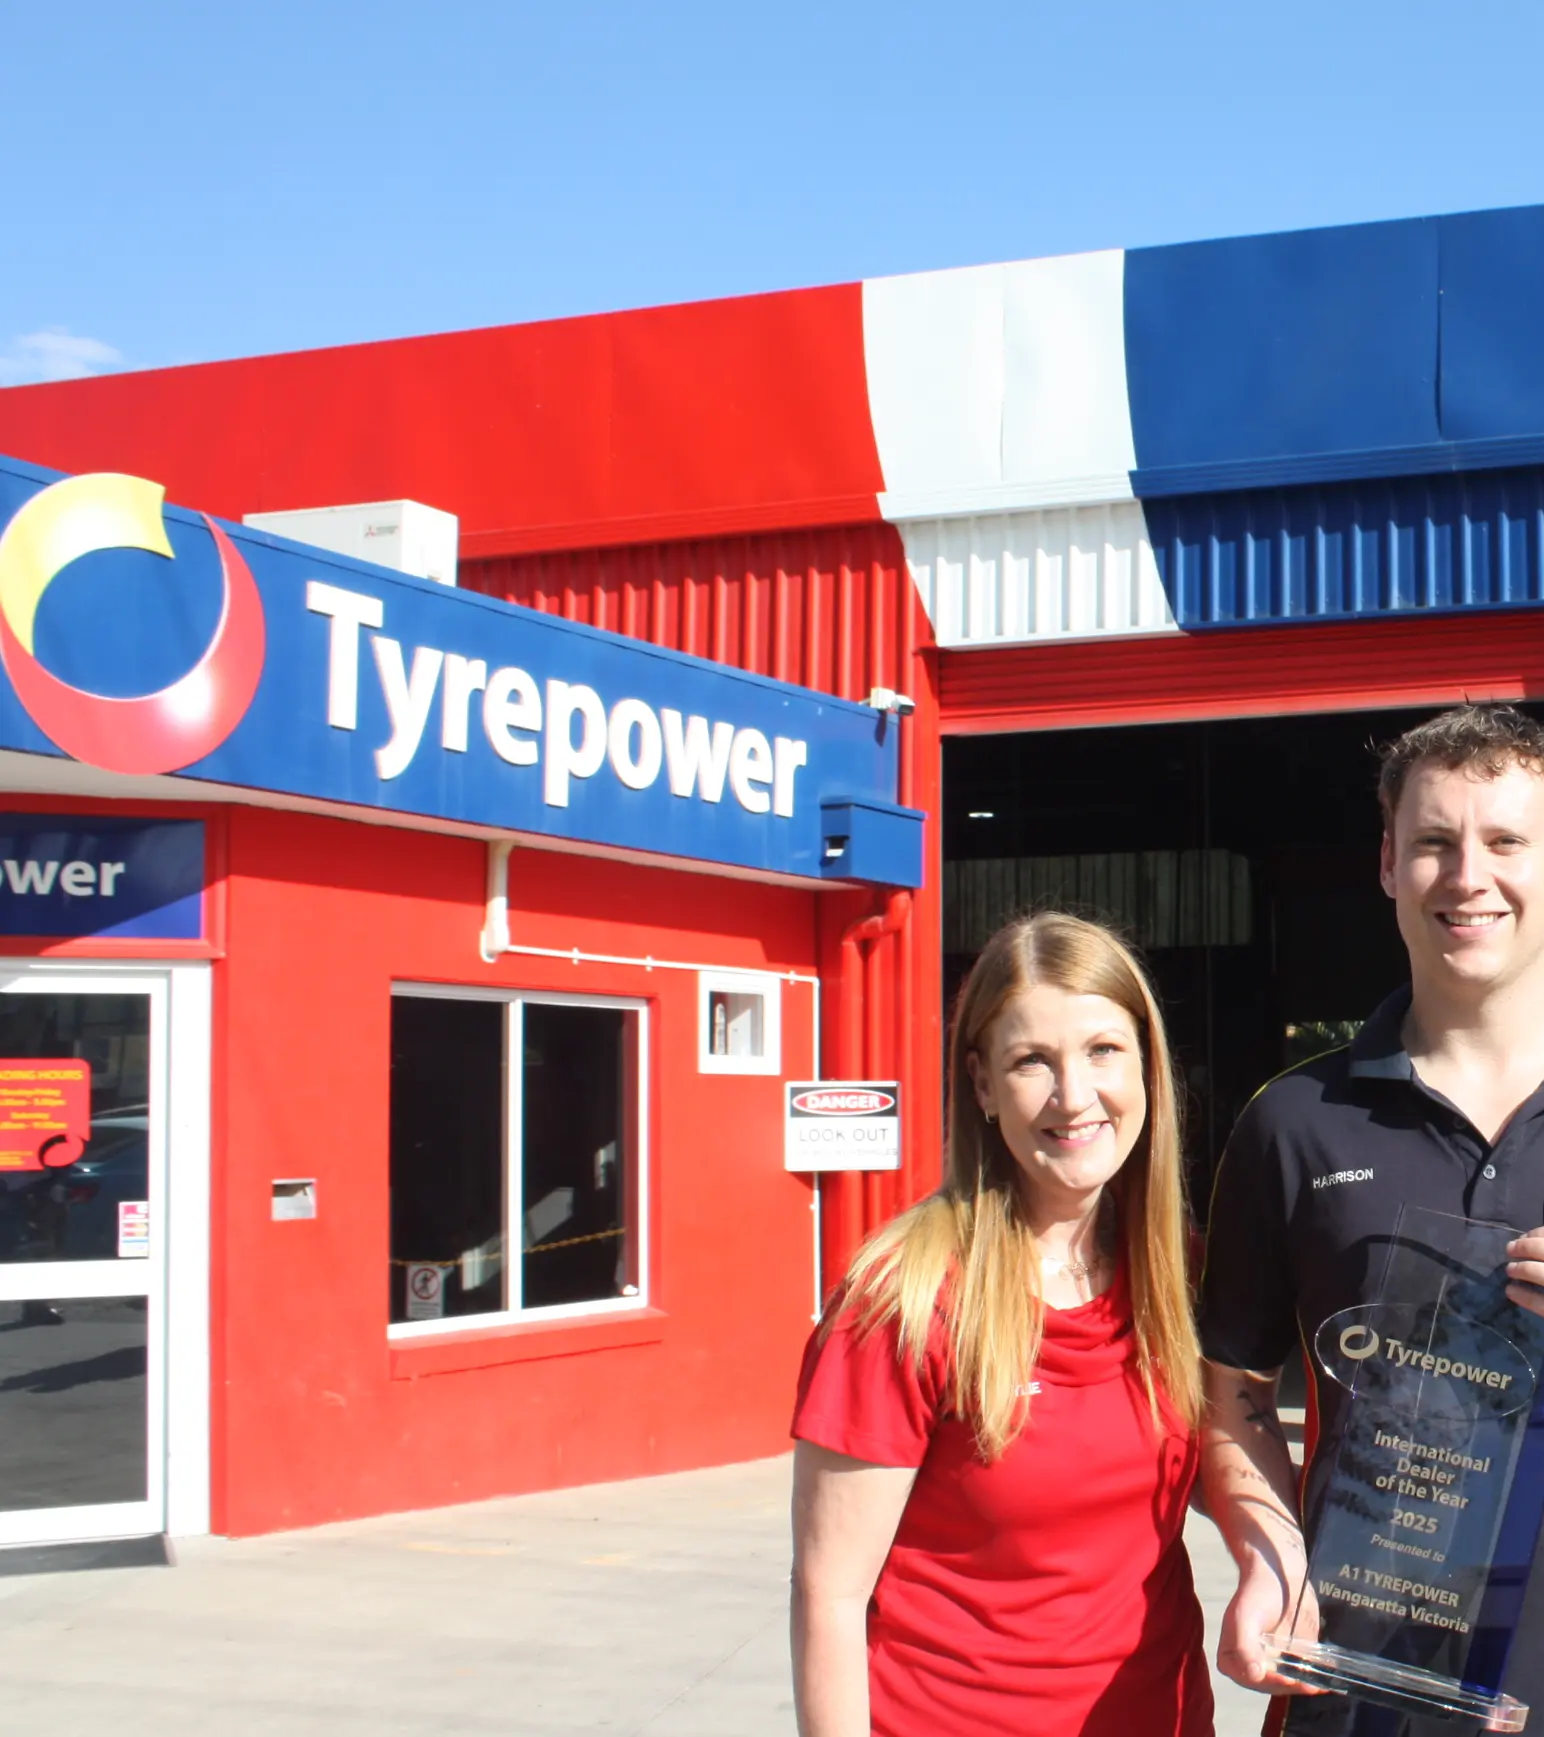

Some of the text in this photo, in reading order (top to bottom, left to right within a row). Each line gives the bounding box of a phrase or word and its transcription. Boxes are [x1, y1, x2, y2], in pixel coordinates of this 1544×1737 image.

[307, 580, 807, 819] Tyrepower
[0, 860, 125, 896] wer
[806, 1094, 881, 1110] DANGER
[799, 1127, 889, 1142] LOOK OUT
[1312, 1167, 1374, 1189] HARRISON
[1385, 1337, 1513, 1390] Tyrepower
[1374, 1429, 1491, 1473] International
[1396, 1457, 1456, 1485] Dealer
[1375, 1474, 1469, 1509] of the Year
[1390, 1508, 1439, 1534] 2025
[1370, 1533, 1446, 1563] Presented to
[1338, 1563, 1461, 1608] A1 TYREPOWER
[1318, 1579, 1470, 1634] Wangaratta Victoria
